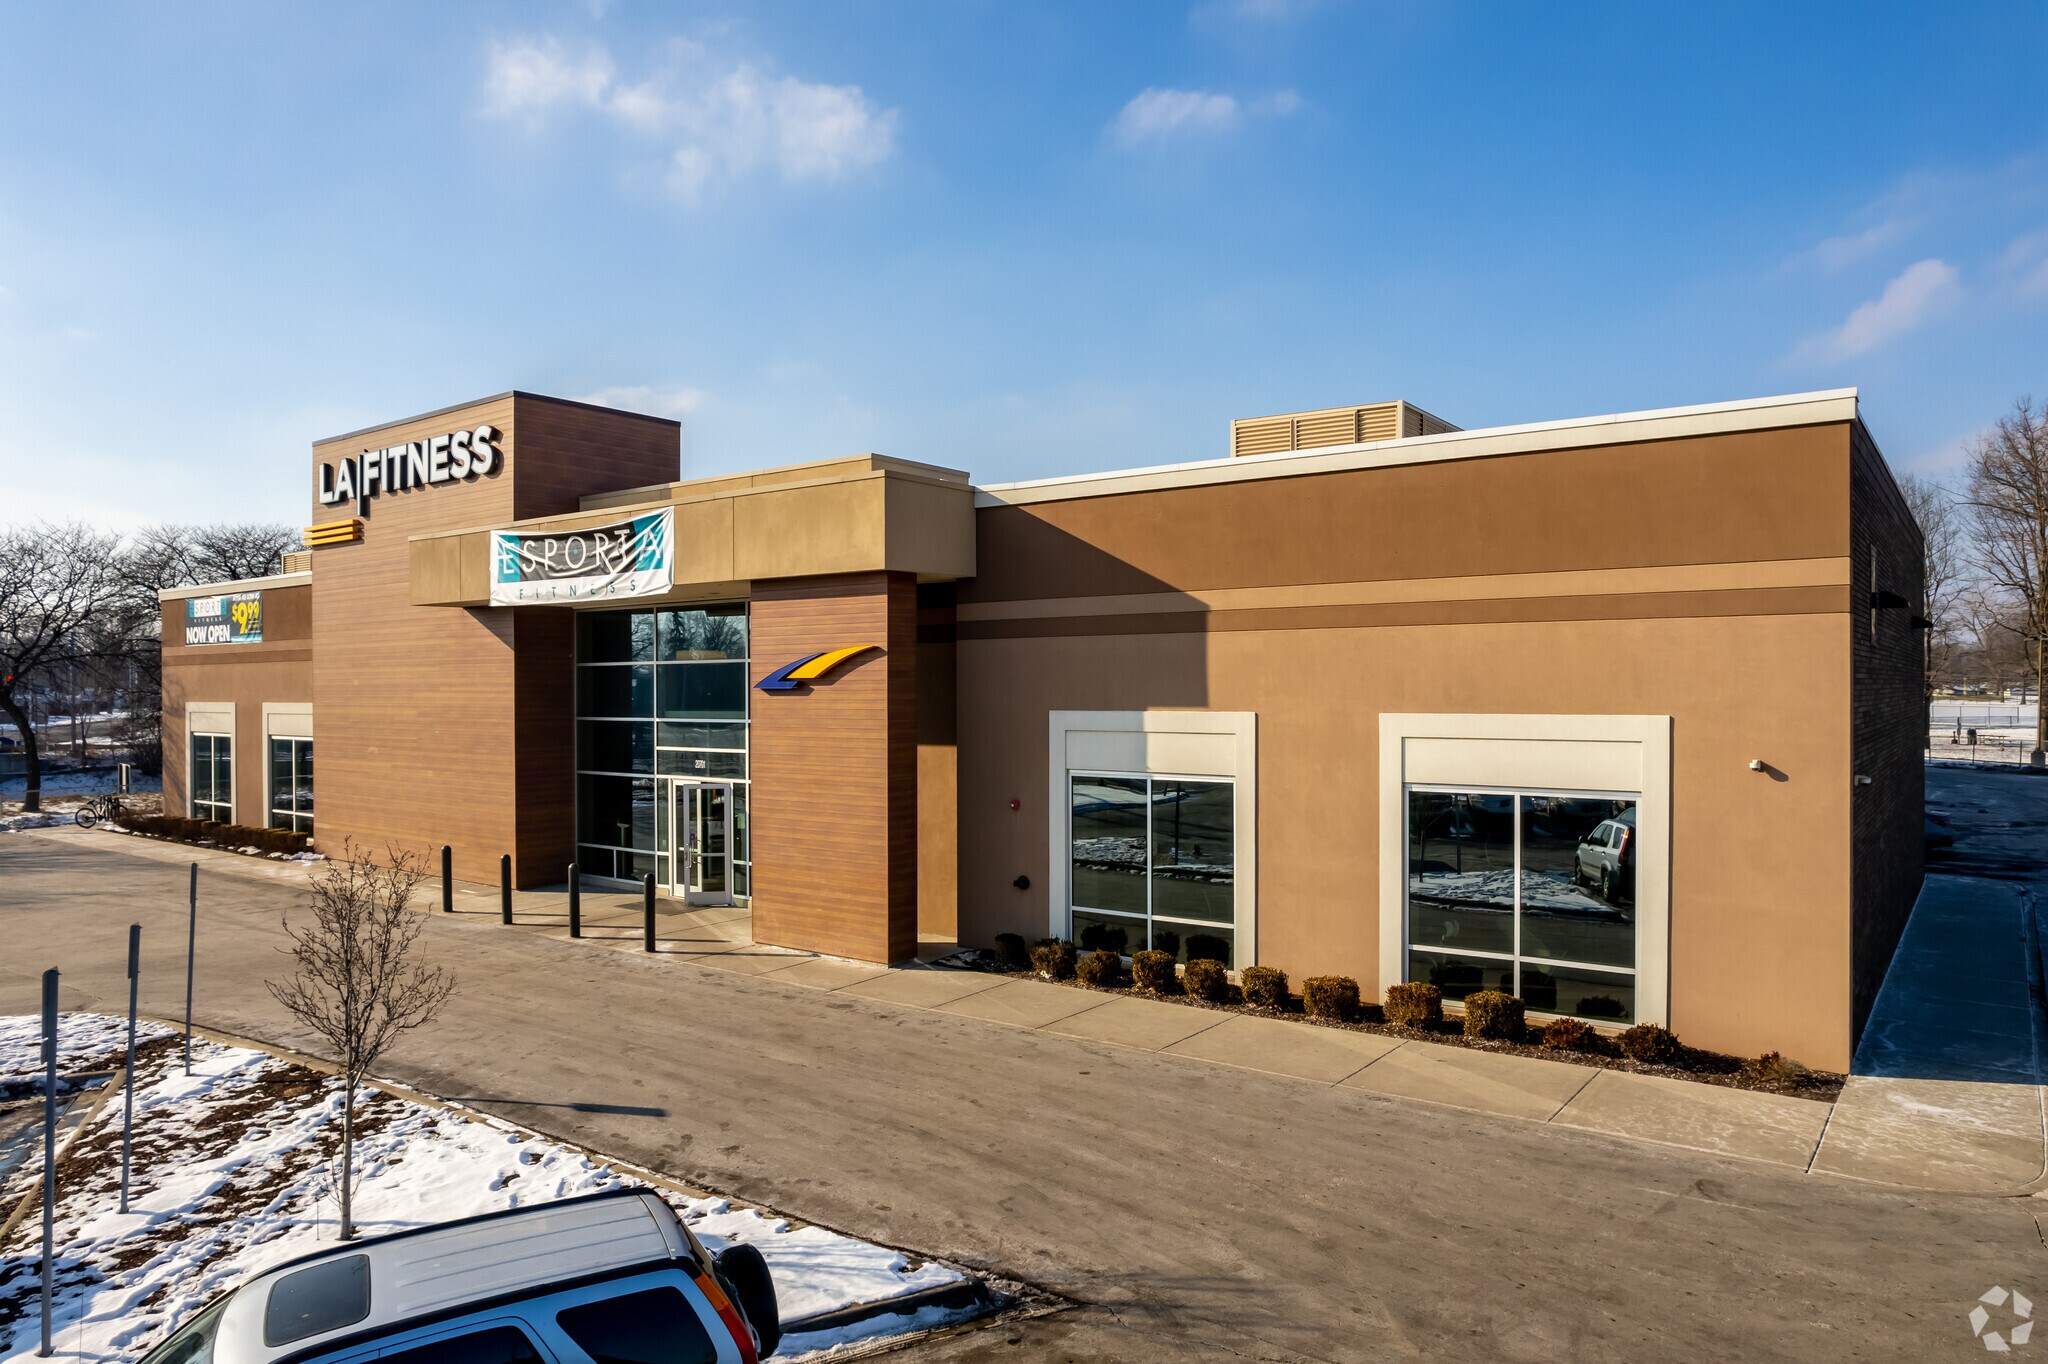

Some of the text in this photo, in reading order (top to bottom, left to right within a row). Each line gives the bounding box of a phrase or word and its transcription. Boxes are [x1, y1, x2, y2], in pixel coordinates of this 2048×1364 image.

[318, 425, 498, 504] LA FITNESS
[498, 528, 661, 575] ESPORTA
[519, 579, 637, 600] FITNESS
[186, 626, 207, 644] NOW
[208, 624, 230, 642] OPEN
